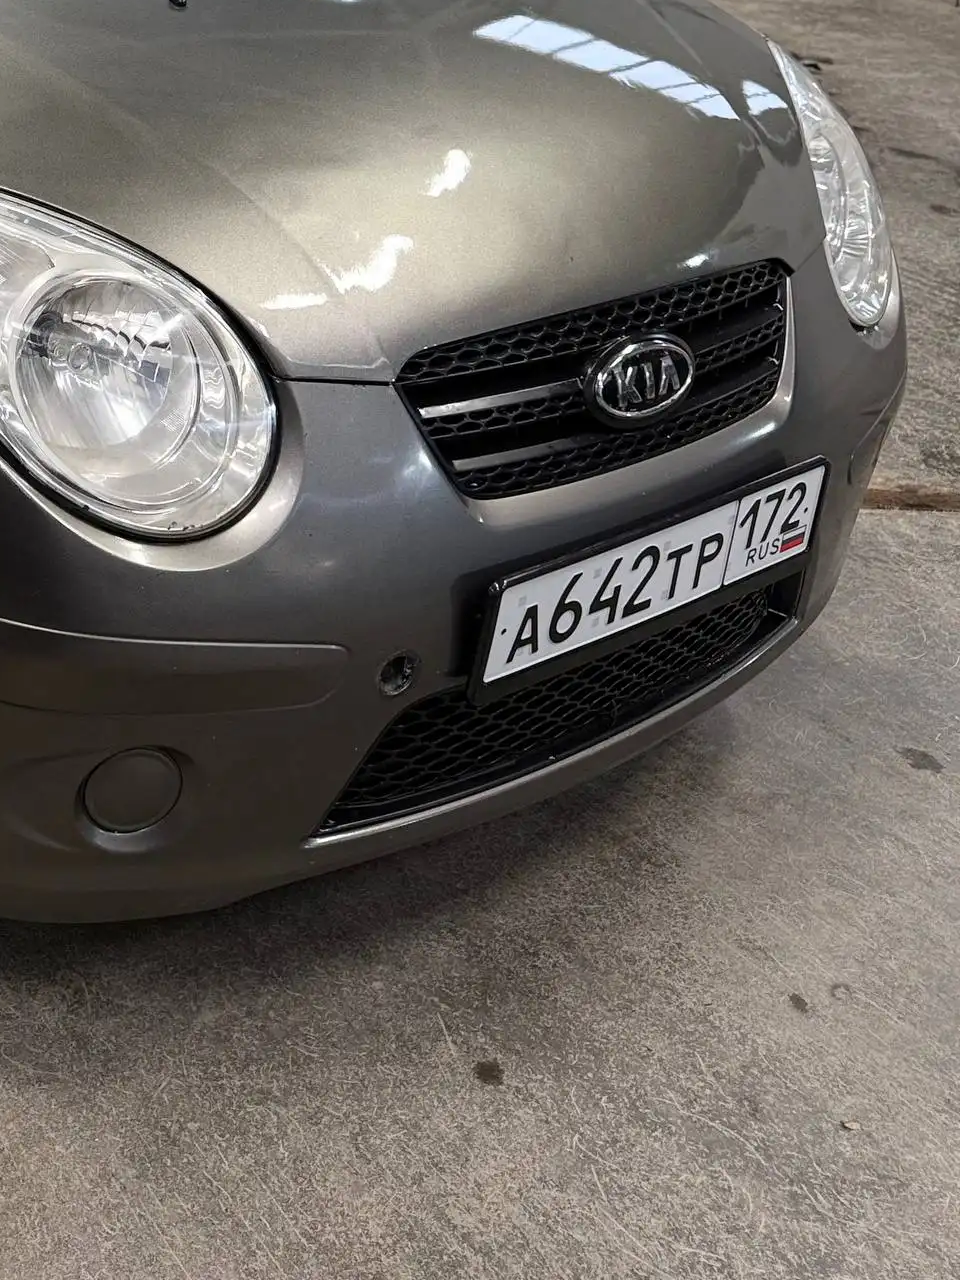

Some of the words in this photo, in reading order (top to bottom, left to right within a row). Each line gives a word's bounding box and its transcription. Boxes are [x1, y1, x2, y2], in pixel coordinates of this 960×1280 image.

[612, 354, 680, 408] KIA
[505, 532, 725, 664] А642ТР
[739, 482, 807, 550] 172
[745, 539, 781, 566] RUS
